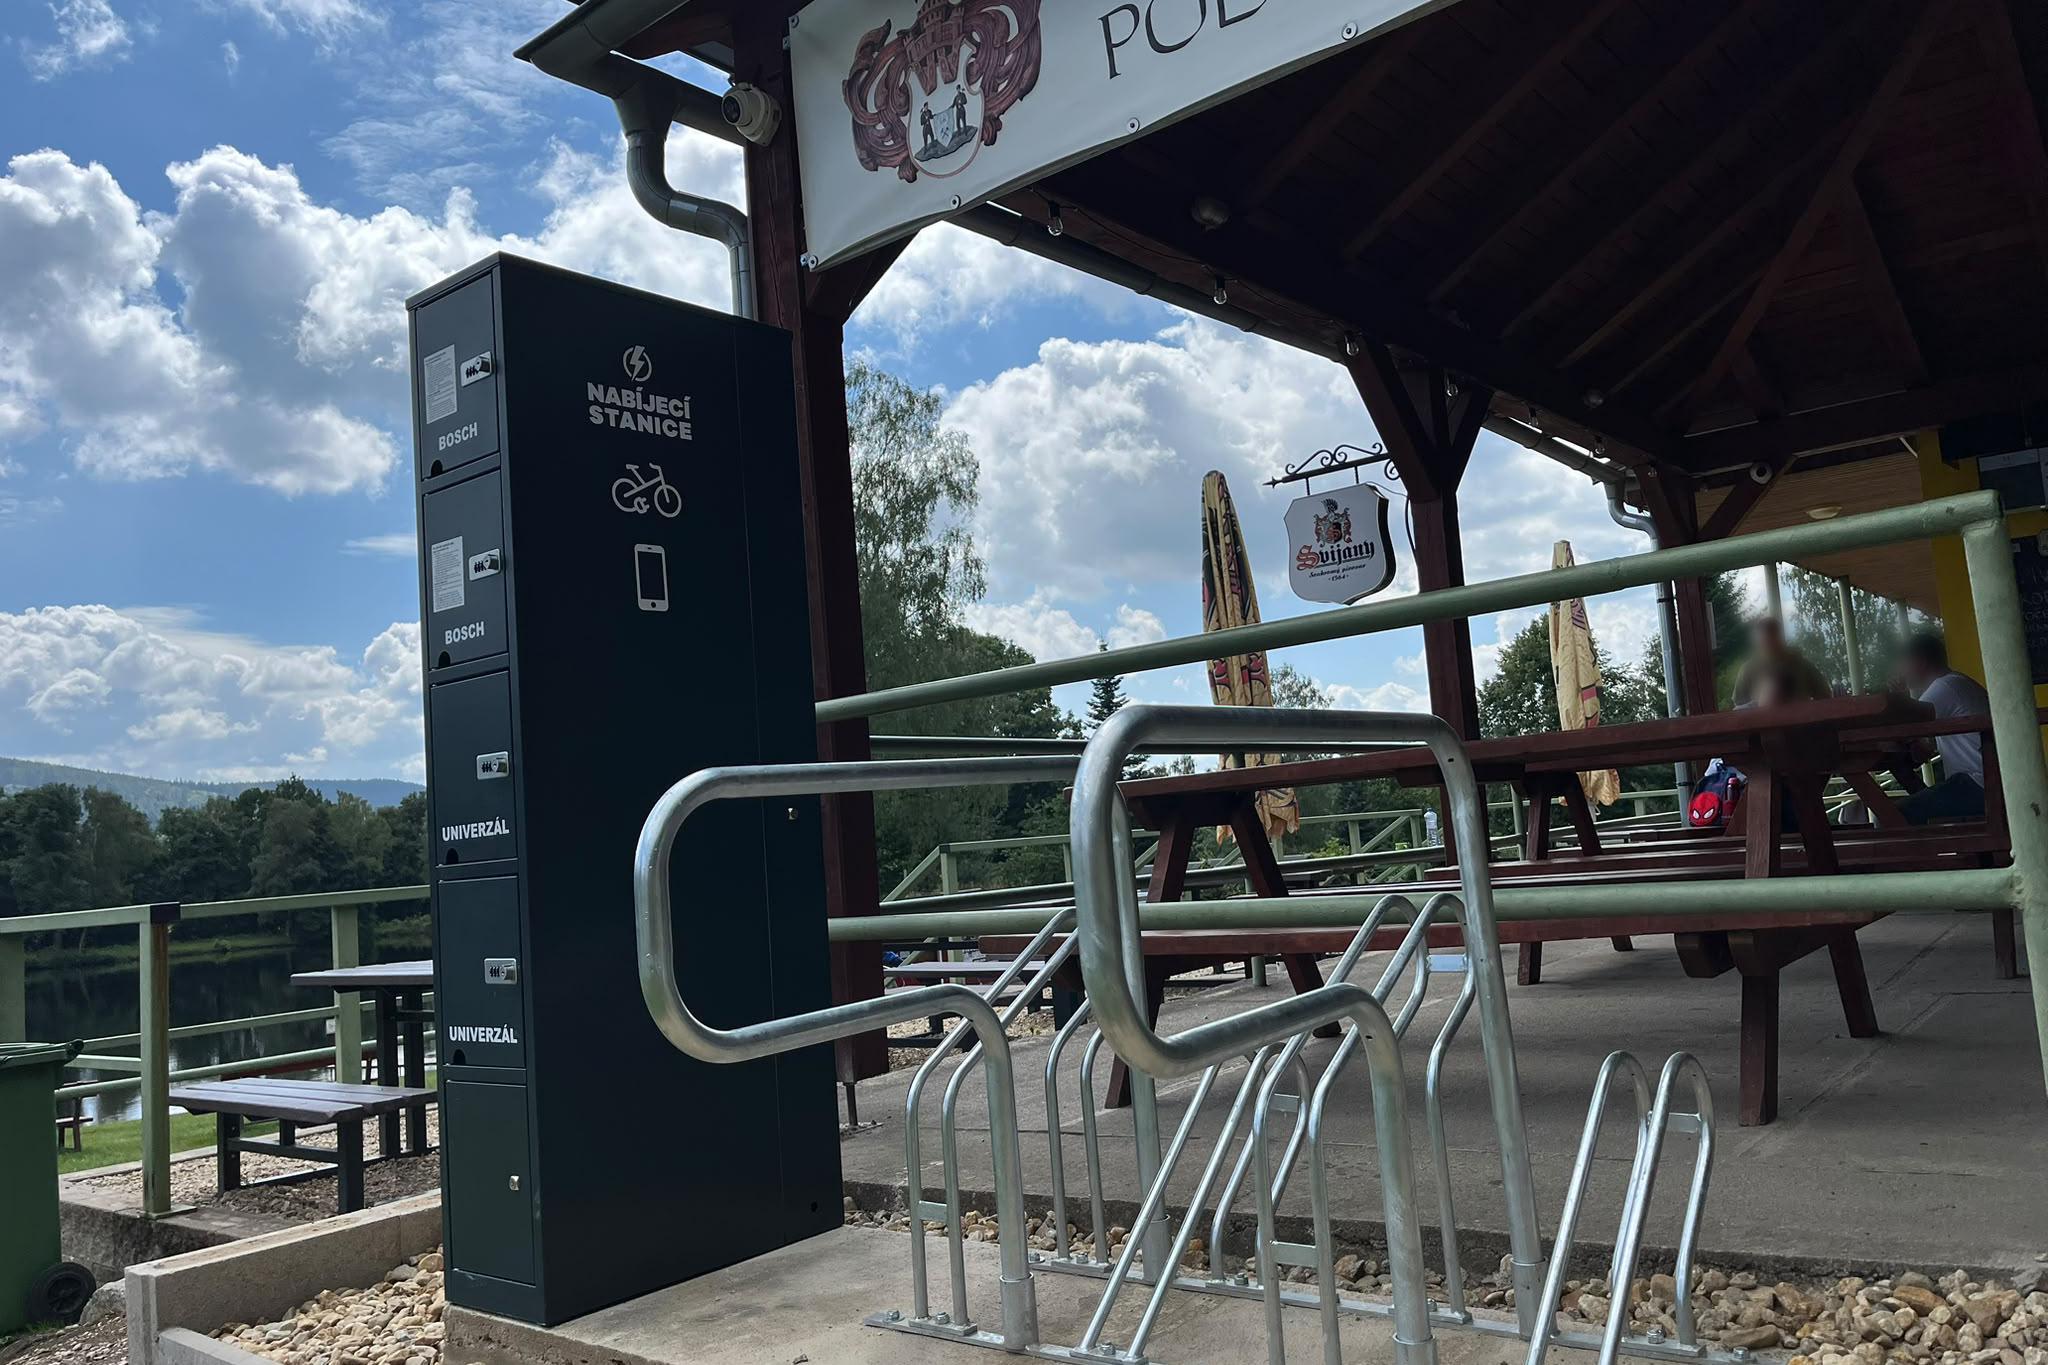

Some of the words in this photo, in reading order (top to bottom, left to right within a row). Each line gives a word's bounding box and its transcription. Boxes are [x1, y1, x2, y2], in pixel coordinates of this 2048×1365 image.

[587, 382, 691, 419] NABÍJECÍ
[439, 421, 478, 451] BOSCH
[589, 405, 692, 440] STANICE
[1296, 541, 1375, 571] Svijany
[445, 621, 485, 645] BOSCH
[442, 816, 510, 841] UNIVERZÁL
[449, 1024, 518, 1043] UNIVERZÁL
